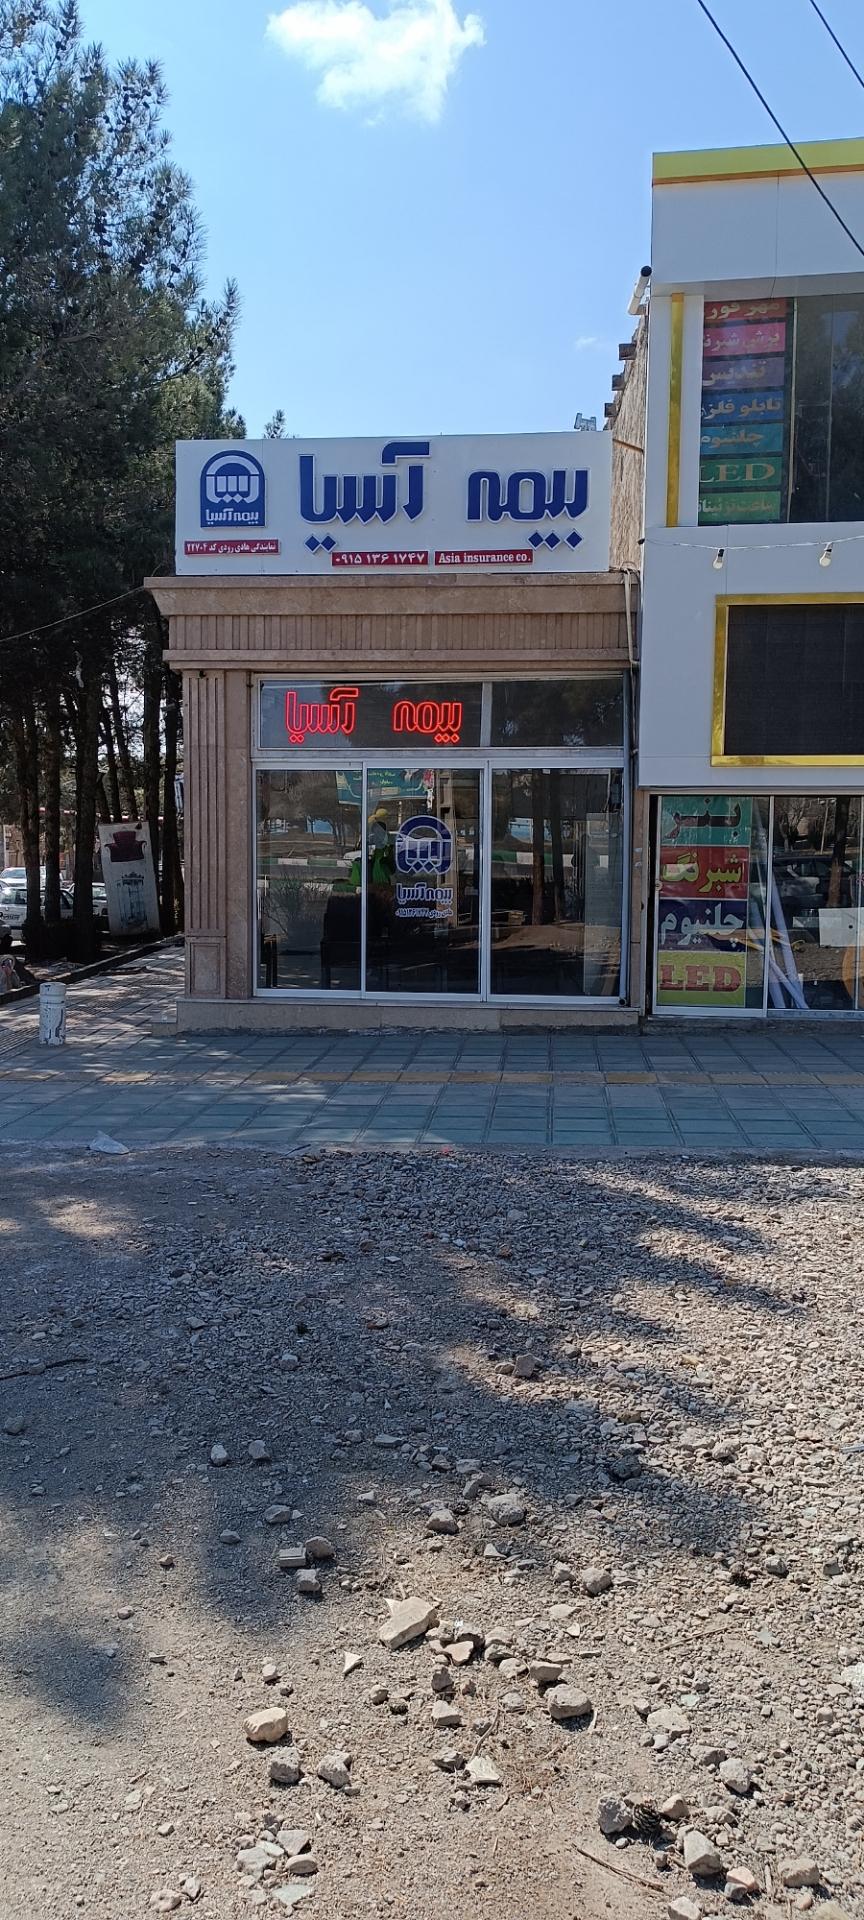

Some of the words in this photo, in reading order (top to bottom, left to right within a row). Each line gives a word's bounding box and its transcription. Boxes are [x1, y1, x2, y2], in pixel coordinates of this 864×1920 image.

[739, 398, 782, 418] تابلو
[699, 463, 776, 483] LED
[299, 441, 431, 554] آسیا
[205, 508, 234, 525] آسیا
[233, 511, 259, 525] بیمه
[467, 466, 591, 551] بیمه
[208, 542, 217, 551] کد
[218, 543, 234, 555] رودی
[235, 541, 250, 554] هادی
[251, 541, 277, 553] نمایندگی
[335, 553, 362, 564] ۰۹۱۵
[366, 553, 389, 564] ۱۳۶
[394, 552, 425, 564] ۱۷۴۷
[439, 552, 461, 564] Asia
[463, 552, 514, 564] insurance
[515, 553, 531, 563] co.
[285, 687, 360, 743] آسیا
[393, 700, 463, 743] بیمه
[663, 797, 743, 840] بنر
[661, 852, 743, 893] شبرنگ
[396, 881, 427, 905] آسیا
[426, 887, 454, 905] بیمه
[660, 964, 743, 993] LED
